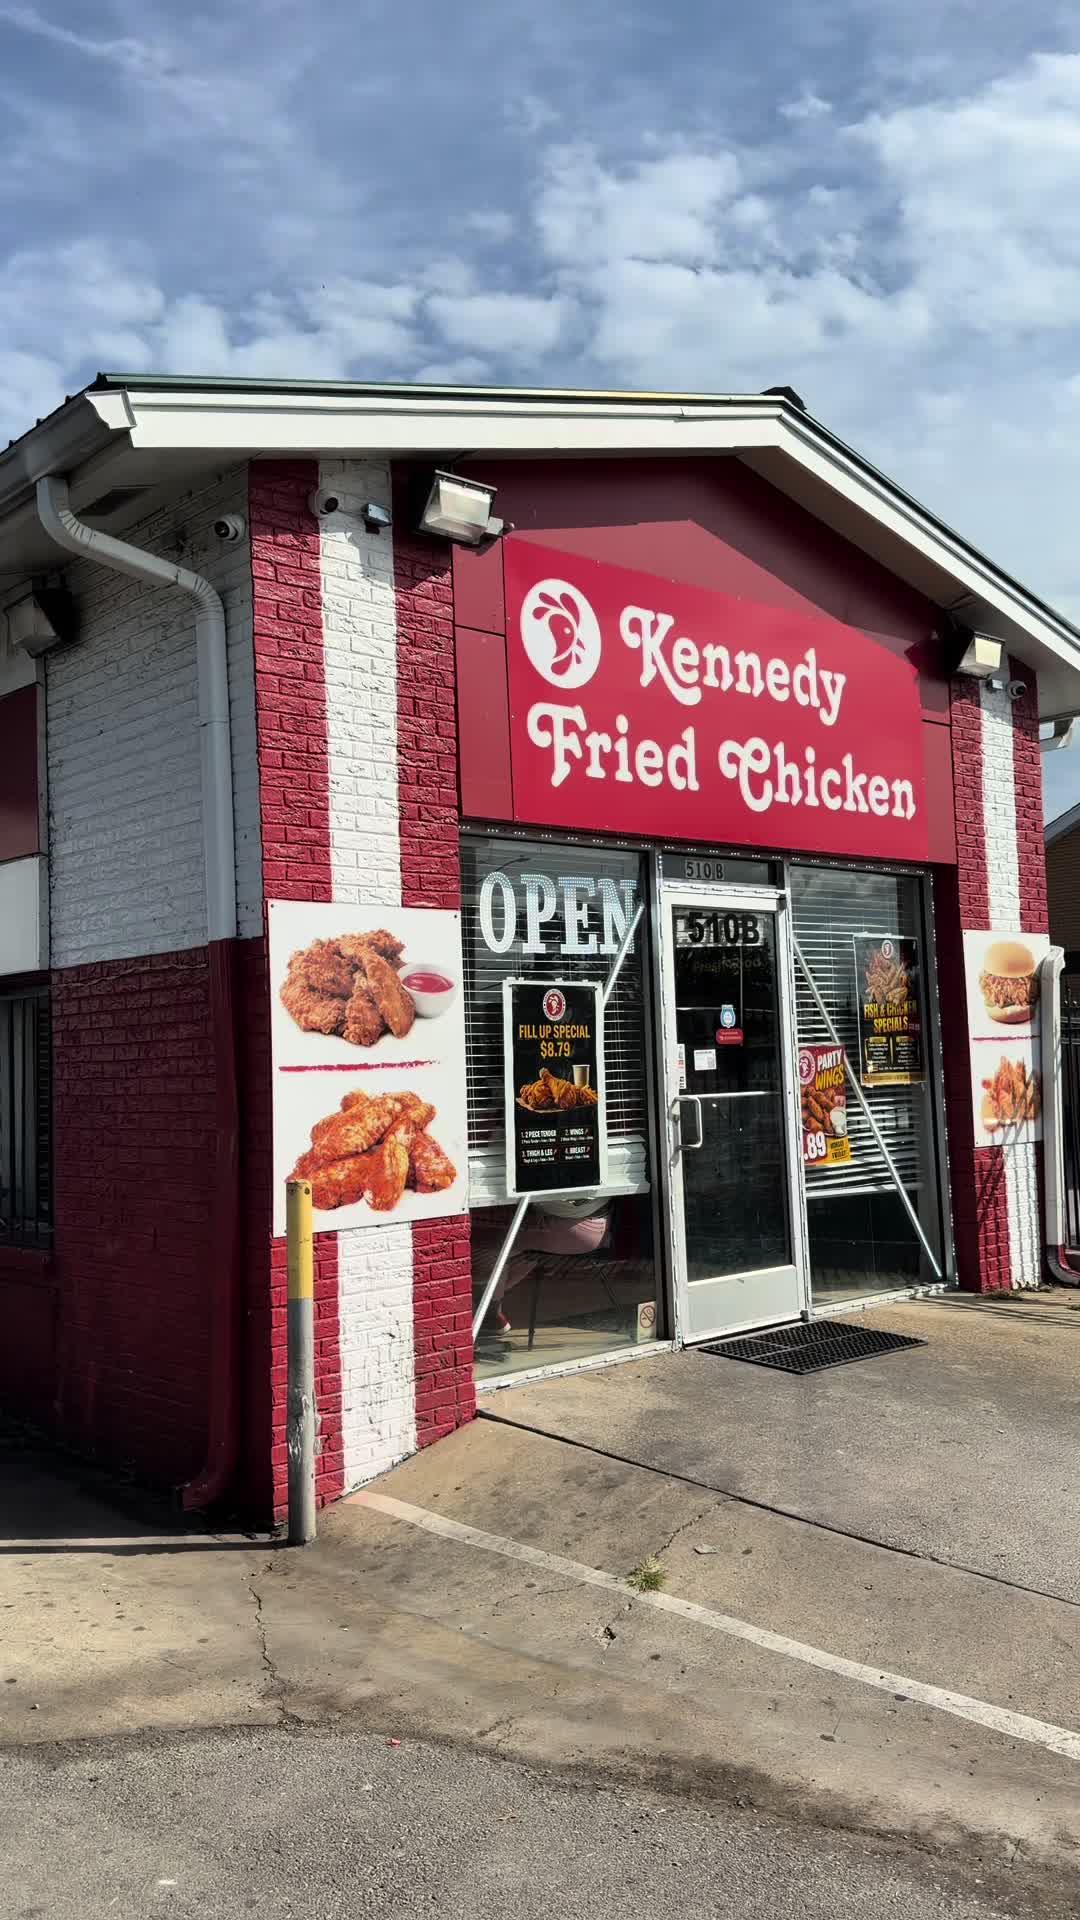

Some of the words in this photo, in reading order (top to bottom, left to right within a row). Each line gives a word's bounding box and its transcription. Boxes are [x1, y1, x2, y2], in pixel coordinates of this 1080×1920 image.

[619, 604, 847, 726] Kennedy
[526, 701, 701, 791] Fried
[717, 736, 917, 821] Chicken
[479, 871, 638, 955] OPEN
[688, 911, 760, 945] 510B
[864, 1003, 879, 1018] FISH
[879, 1003, 886, 1017] &
[886, 1000, 917, 1017] CHICKEN
[519, 1024, 538, 1039] FILL
[539, 1025, 552, 1039] UP
[553, 1024, 591, 1039] SPECIAL
[873, 1016, 909, 1033] SPECIALS
[540, 1041, 571, 1059] $8.79
[817, 1049, 843, 1071] PARTY
[815, 1064, 845, 1090] WINGS
[528, 1130, 541, 1138] PIECE
[540, 1129, 557, 1137] TENDER
